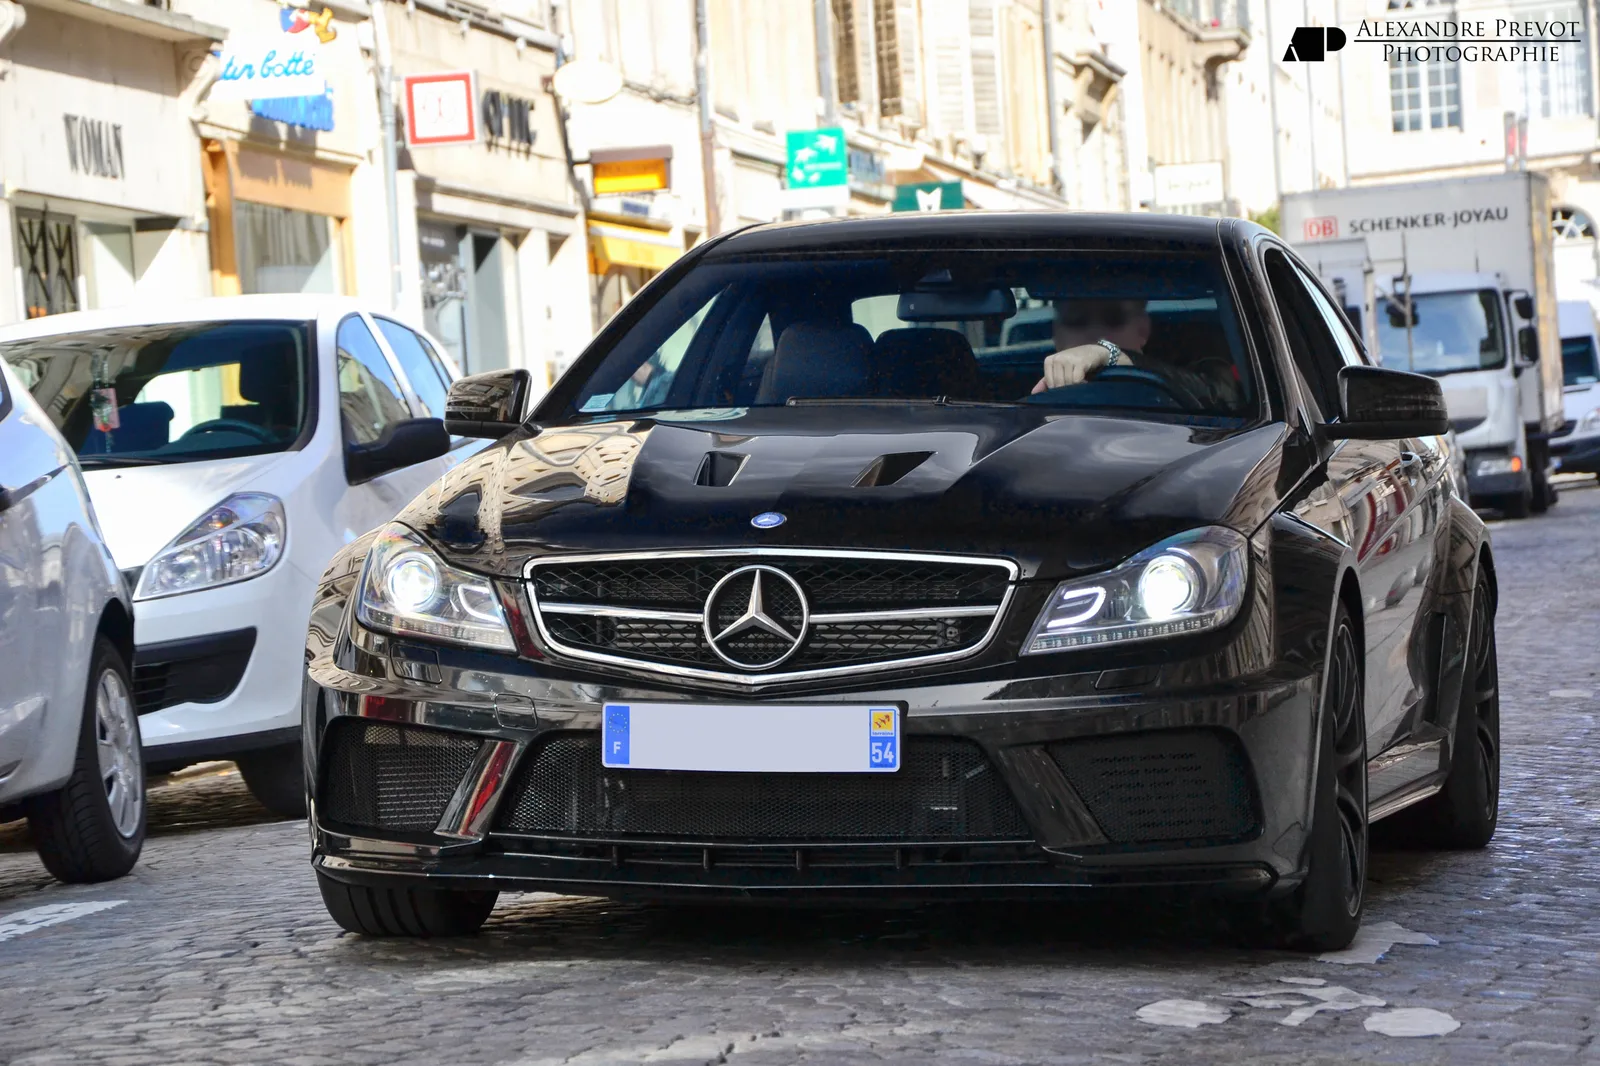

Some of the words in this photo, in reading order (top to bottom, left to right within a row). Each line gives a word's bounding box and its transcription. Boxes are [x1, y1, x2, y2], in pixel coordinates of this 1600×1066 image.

[63, 112, 125, 181] WOMAN
[1307, 220, 1335, 238] DB
[1349, 207, 1509, 234] SCHENKER-JOYAU
[613, 741, 622, 755] F
[871, 742, 895, 763] 54
